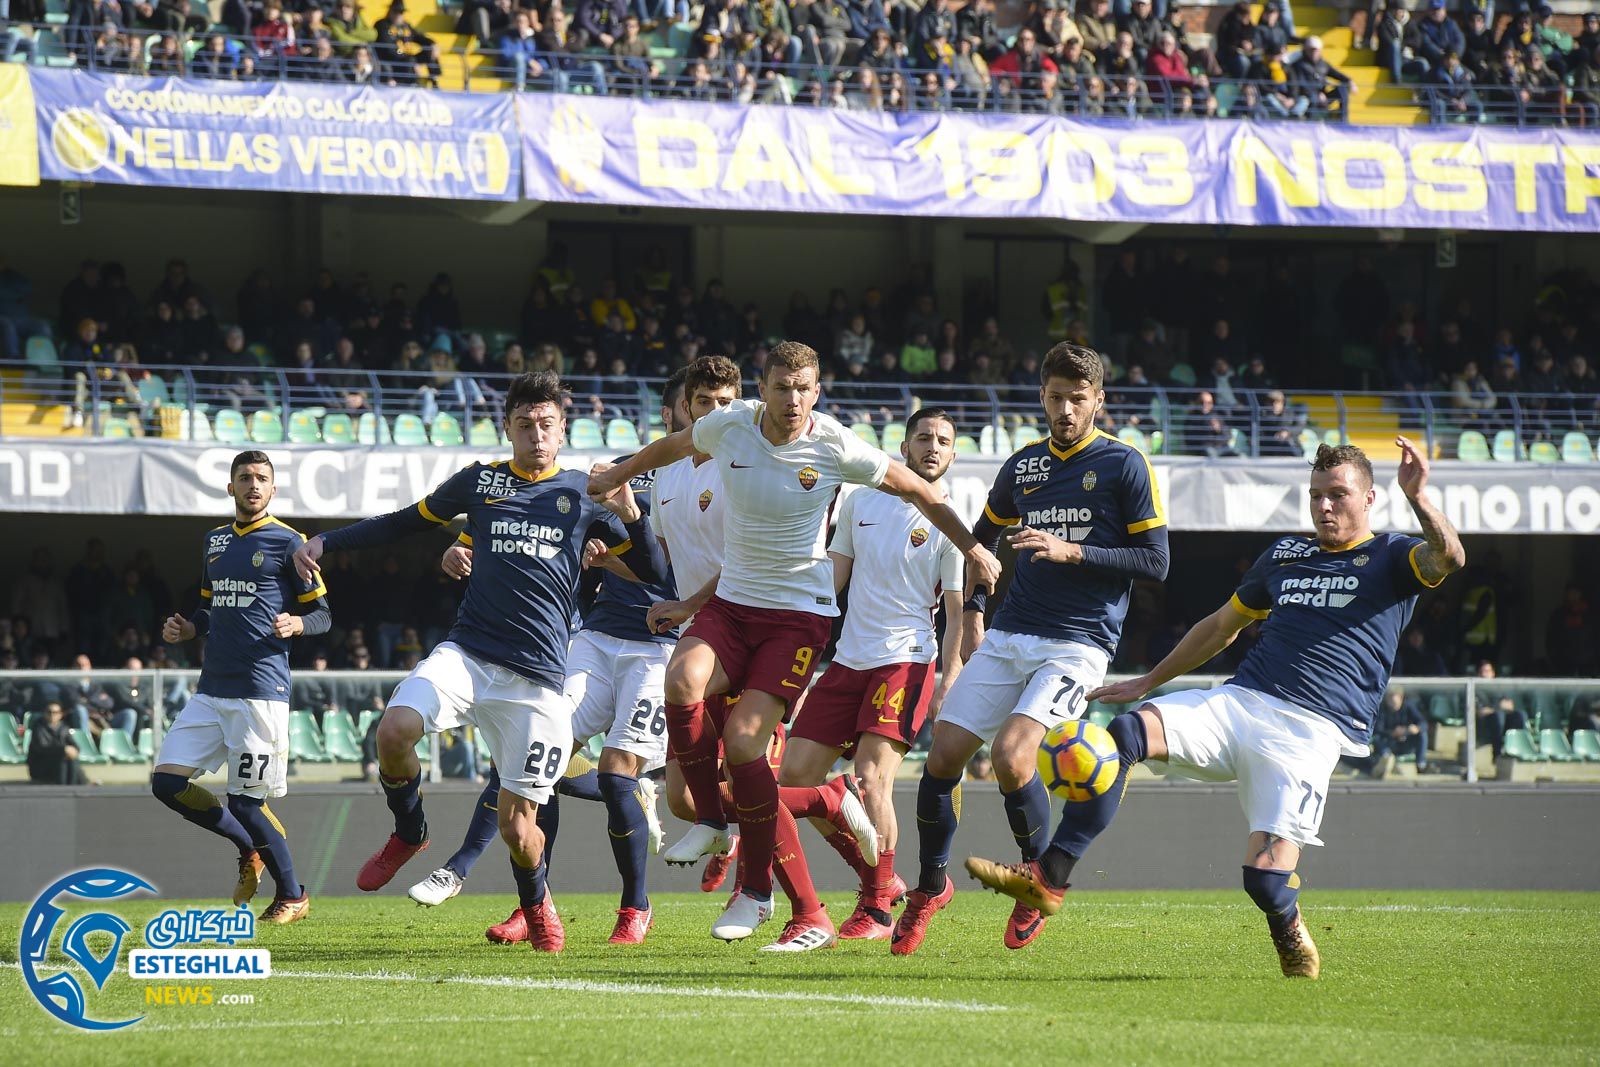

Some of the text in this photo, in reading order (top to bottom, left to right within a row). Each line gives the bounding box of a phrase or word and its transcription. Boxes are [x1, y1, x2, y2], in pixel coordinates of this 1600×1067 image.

[105, 87, 453, 126] COORDINAMENTO CALCIO CLUB
[114, 127, 466, 182] HELLAS VERONA
[633, 116, 875, 196] DAL
[915, 121, 1195, 205] 1903
[1014, 456, 1051, 474] SEC
[478, 469, 519, 488] SEC
[1015, 472, 1049, 484] EVENTS
[476, 484, 517, 497] EVENTS
[1027, 505, 1092, 525] metano
[210, 533, 233, 547] SEC
[490, 519, 564, 543] metano
[491, 538, 537, 558] nord
[212, 578, 257, 593] metano
[1281, 575, 1359, 592] metano
[212, 592, 236, 608] nord
[1278, 589, 1327, 607] nord
[792, 646, 813, 677] 9
[871, 682, 906, 714] 44
[1052, 675, 1085, 715] 70
[630, 698, 666, 736] 26
[238, 753, 269, 780] 27
[524, 741, 562, 779] 28
[1298, 780, 1323, 824] 77
